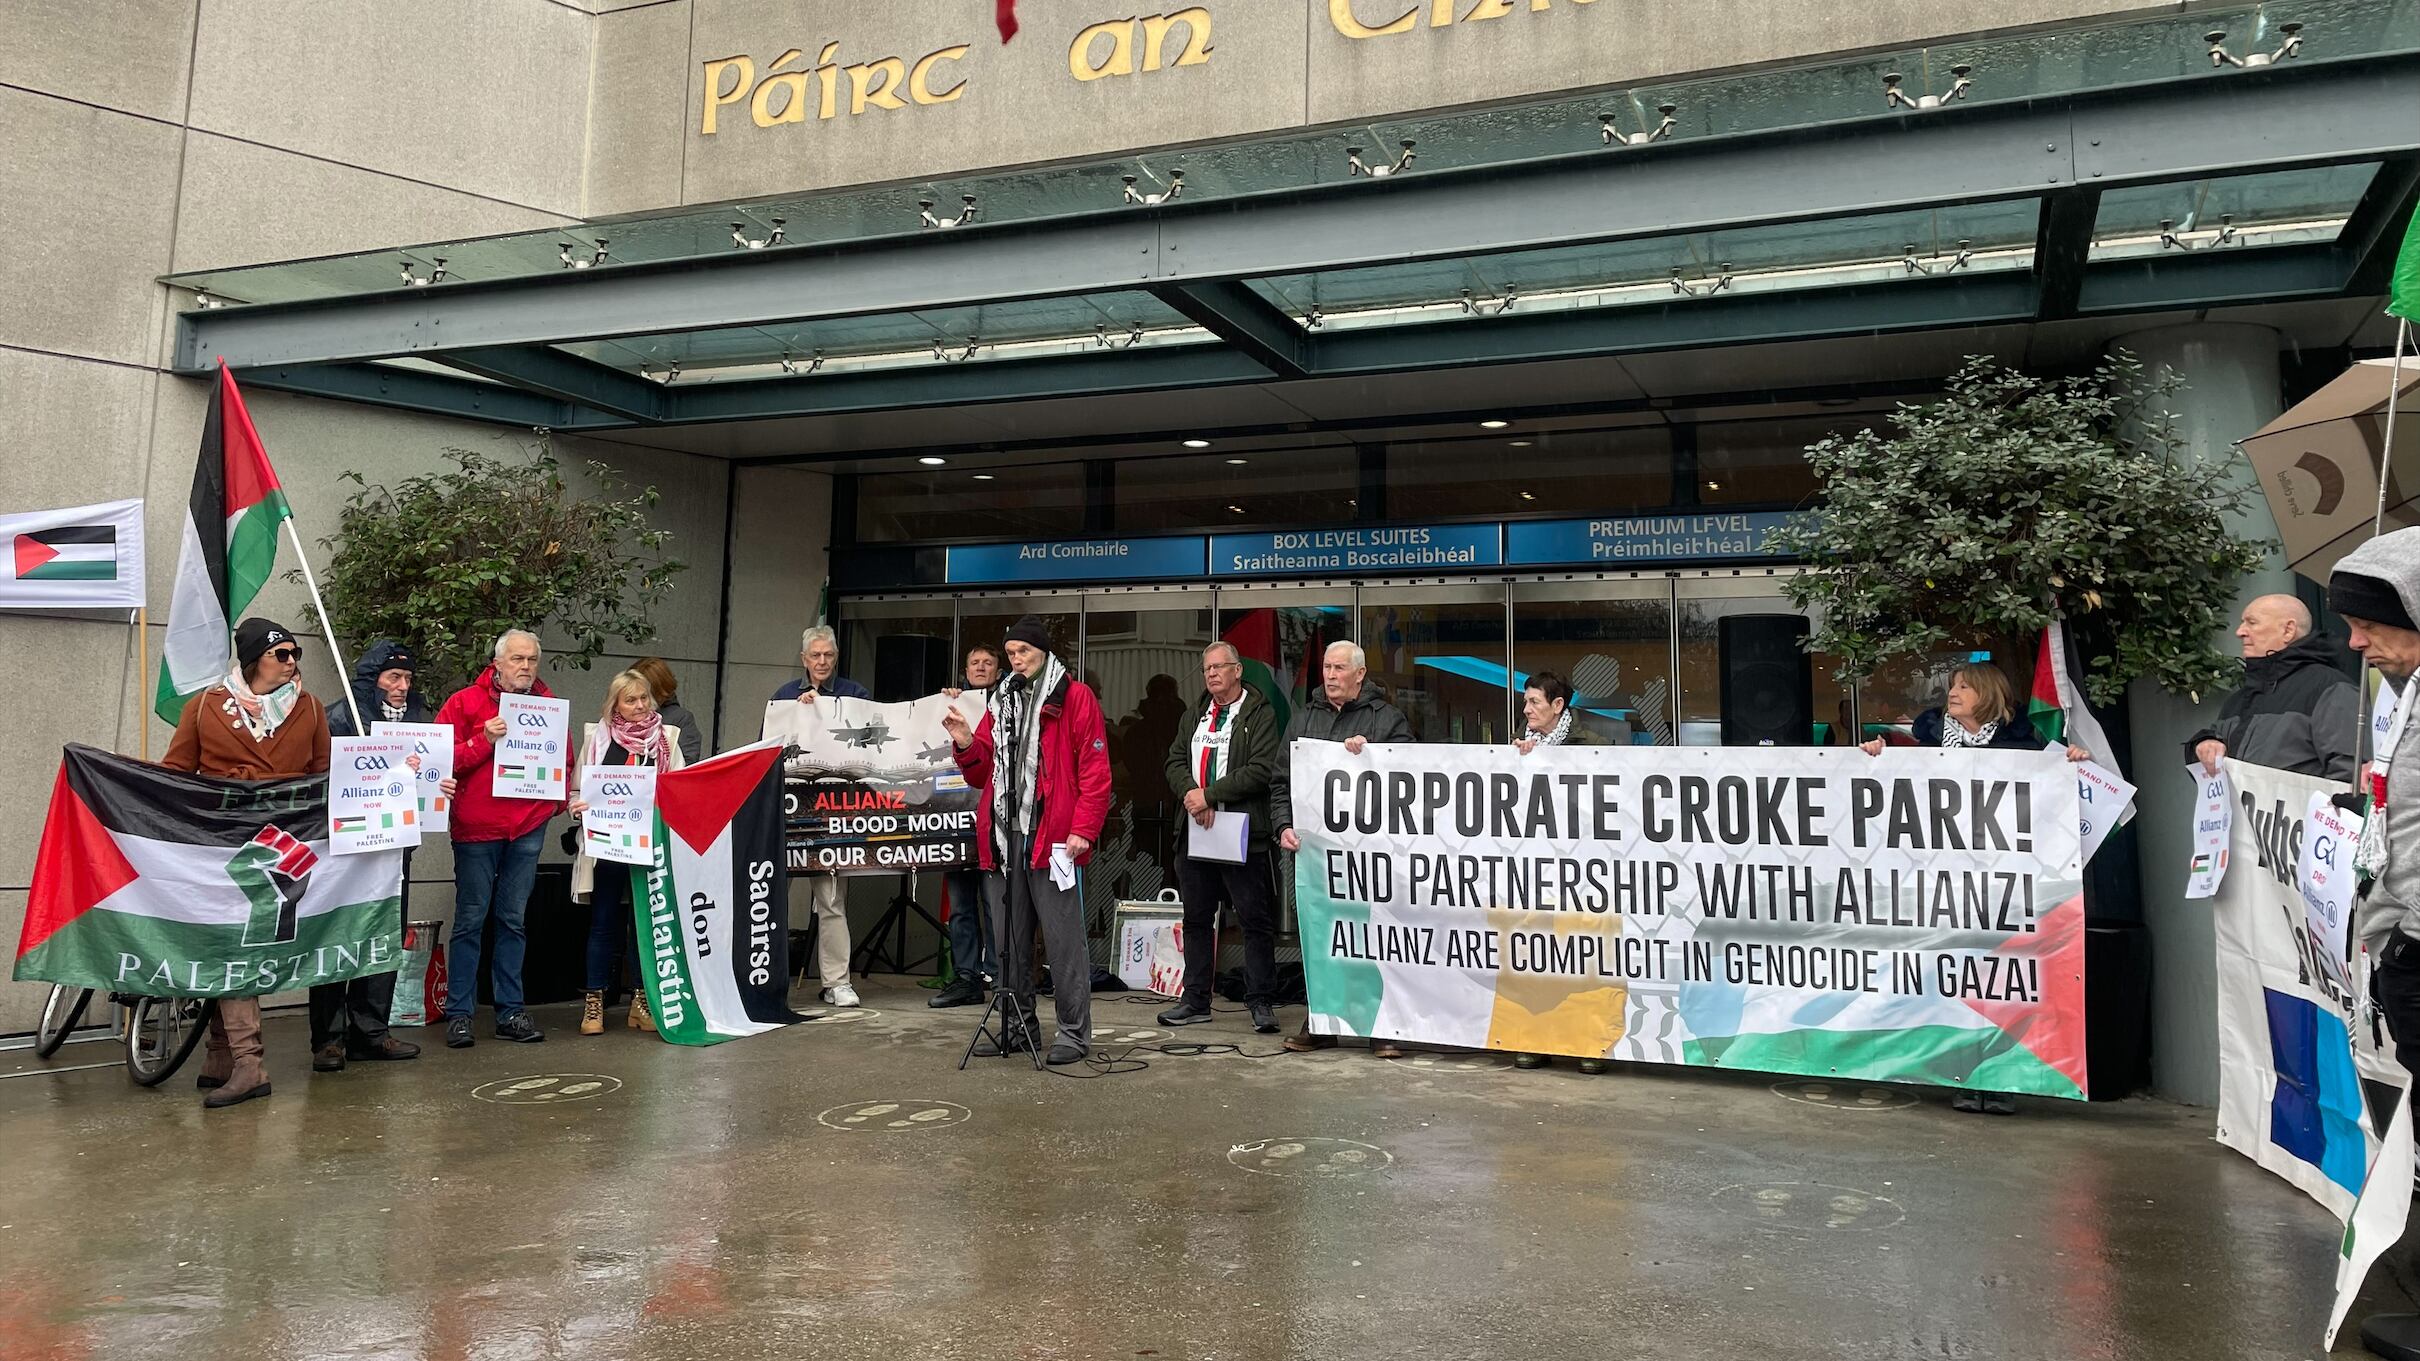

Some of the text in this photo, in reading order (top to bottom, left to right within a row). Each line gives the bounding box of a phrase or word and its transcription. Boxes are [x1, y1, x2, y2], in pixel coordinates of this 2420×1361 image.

[701, 8, 1215, 135] Páirc an
[1273, 528, 1430, 550] BOX LEVEL SUITES
[1589, 518, 1685, 538] PREMIUM
[1019, 541, 1129, 559] Ard Comhairle
[1592, 535, 1751, 558] Préimhleibhéal
[1233, 545, 1475, 571] Sraitheanna Boscaleibhéal
[506, 739, 542, 751] Allianz
[341, 787, 385, 799] Allianz
[2103, 782, 2120, 795] THE
[814, 790, 907, 811] ALLIANZ
[1323, 769, 2033, 853] CORPORATE CROKE PARK!
[590, 809, 626, 820] Allianz
[828, 815, 898, 834] BLOOD
[2314, 808, 2325, 823] WE
[356, 838, 395, 847] PALESTINE
[786, 848, 808, 868] IN
[819, 846, 866, 867] OUR
[1326, 849, 2036, 933] END PARTNERSHIP WITH ALLIANZ!
[690, 891, 716, 960] don
[748, 859, 777, 986] Saoirse
[647, 843, 692, 1030] Phalaistín
[114, 934, 394, 993] PALESTINE
[1331, 920, 2039, 1003] ALLIANZ ARE COMPLICIT IN GENOCIDE IN GAZA!
